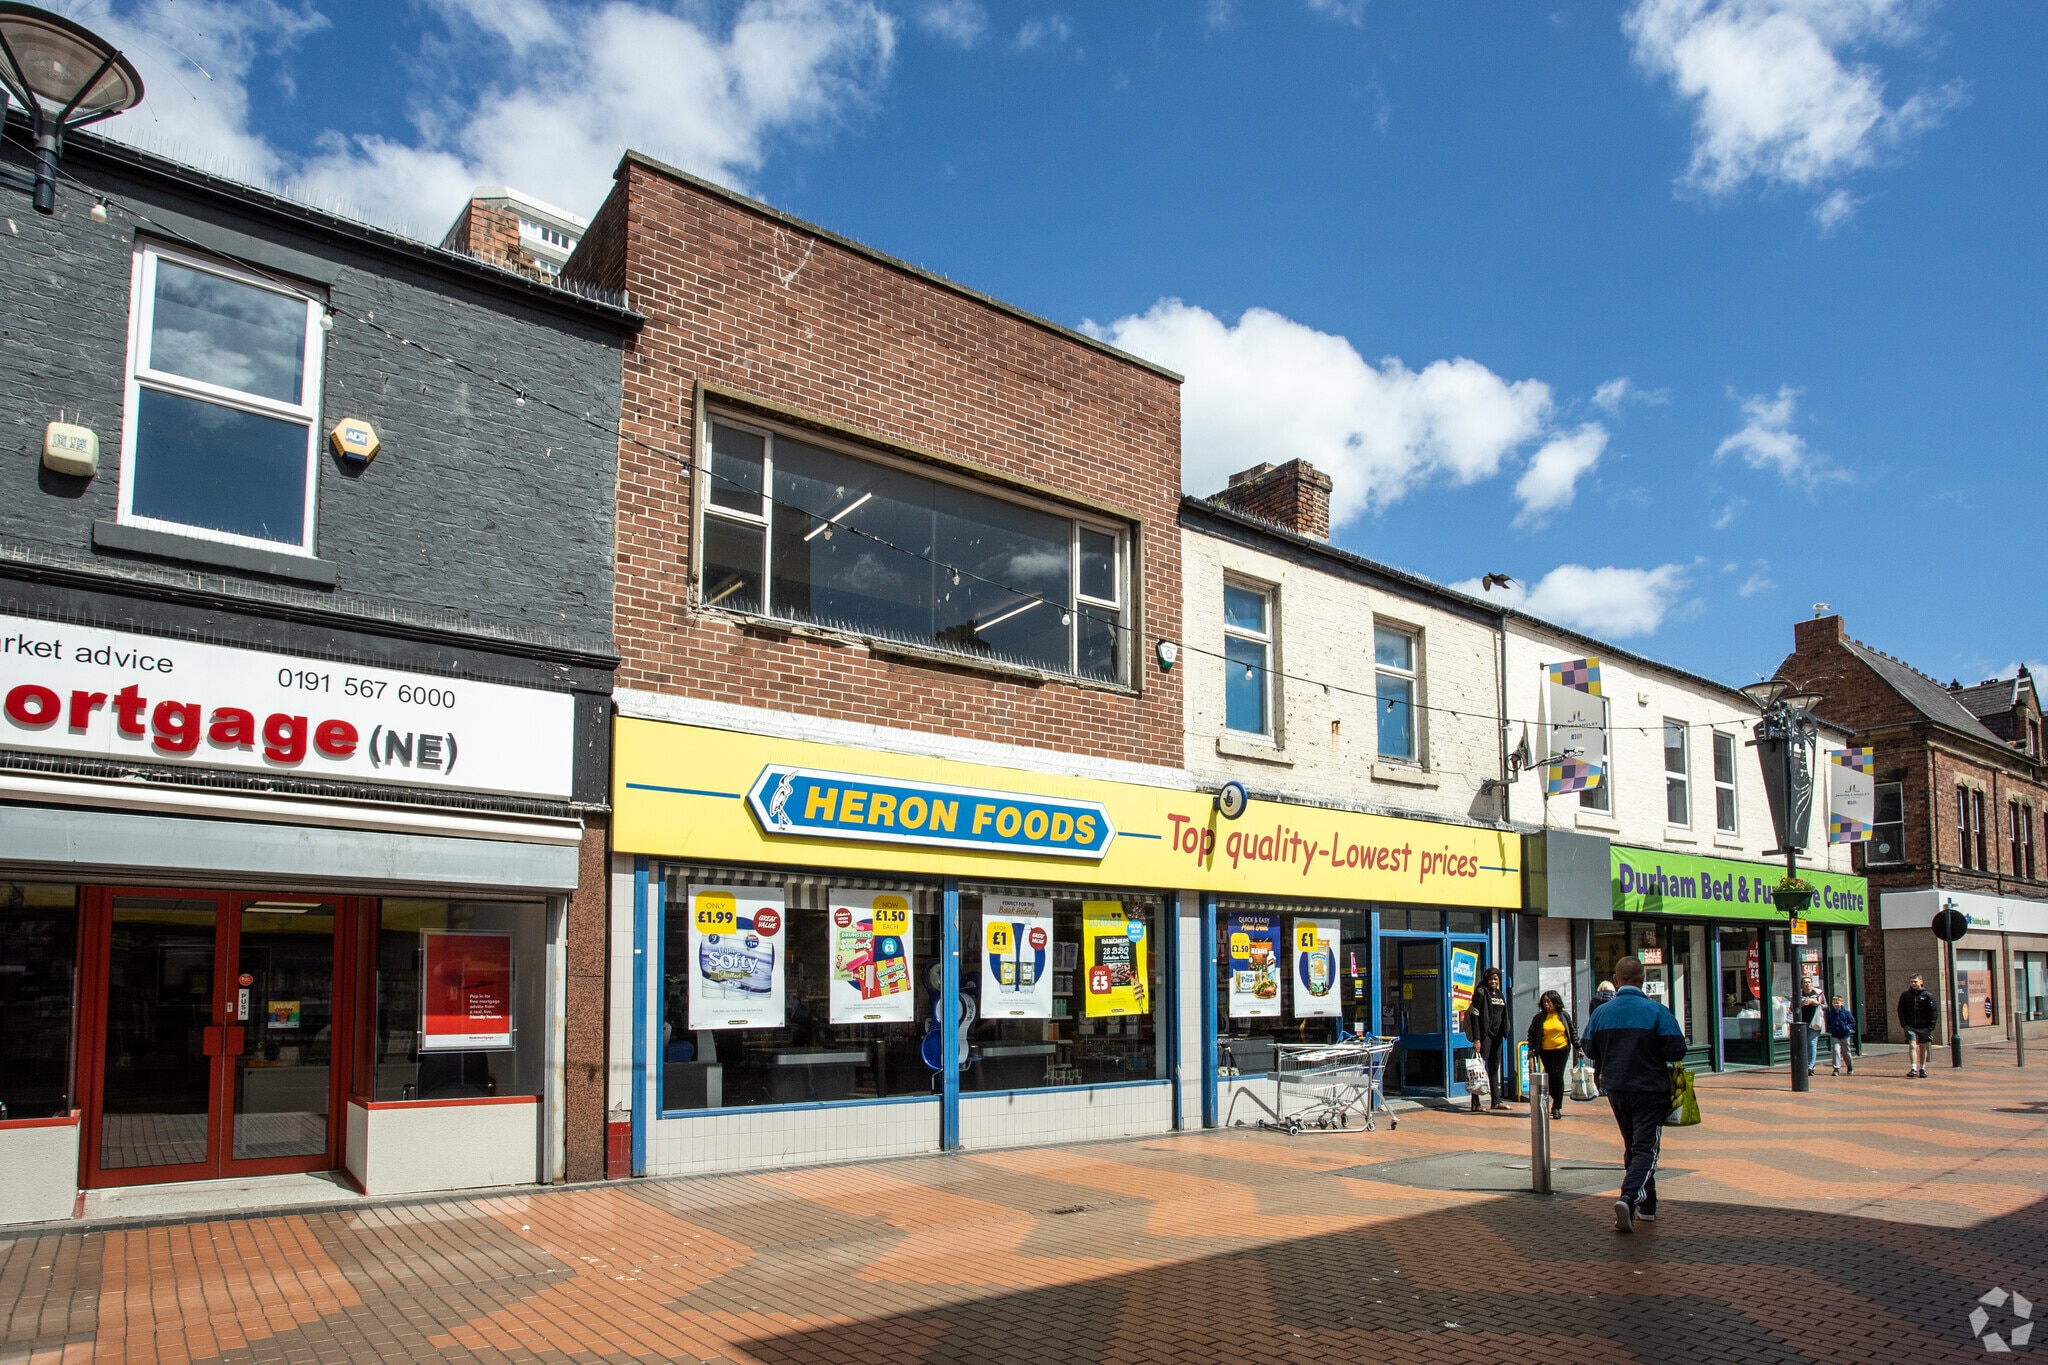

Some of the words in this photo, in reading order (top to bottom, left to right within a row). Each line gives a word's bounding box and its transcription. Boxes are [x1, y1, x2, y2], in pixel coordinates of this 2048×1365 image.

[346, 431, 368, 443] ADT
[0, 634, 62, 660] rket
[75, 645, 173, 673] advice
[278, 668, 330, 693] 0191
[344, 677, 388, 700] 567
[398, 684, 456, 709] 6000
[370, 725, 458, 773] (NE)
[804, 786, 959, 832] HERON
[971, 803, 1096, 845] FOODS
[1167, 813, 1215, 867] Top
[1419, 844, 1478, 884] prices
[1619, 863, 1697, 898] Durham
[1700, 871, 1733, 901] Bed
[1737, 875, 1750, 903] &
[1823, 884, 1864, 912] Centre
[697, 911, 734, 924] £1.99
[758, 914, 778, 922] GREAT
[875, 910, 906, 921] £1.50
[757, 921, 778, 929] VALUE
[992, 931, 1006, 945] £1
[1301, 932, 1314, 947] £1
[1231, 945, 1249, 953] £2.50
[1644, 948, 1661, 958] SALE
[708, 950, 759, 975] Softy
[1803, 964, 1817, 974] SALE
[1092, 976, 1108, 991] £5
